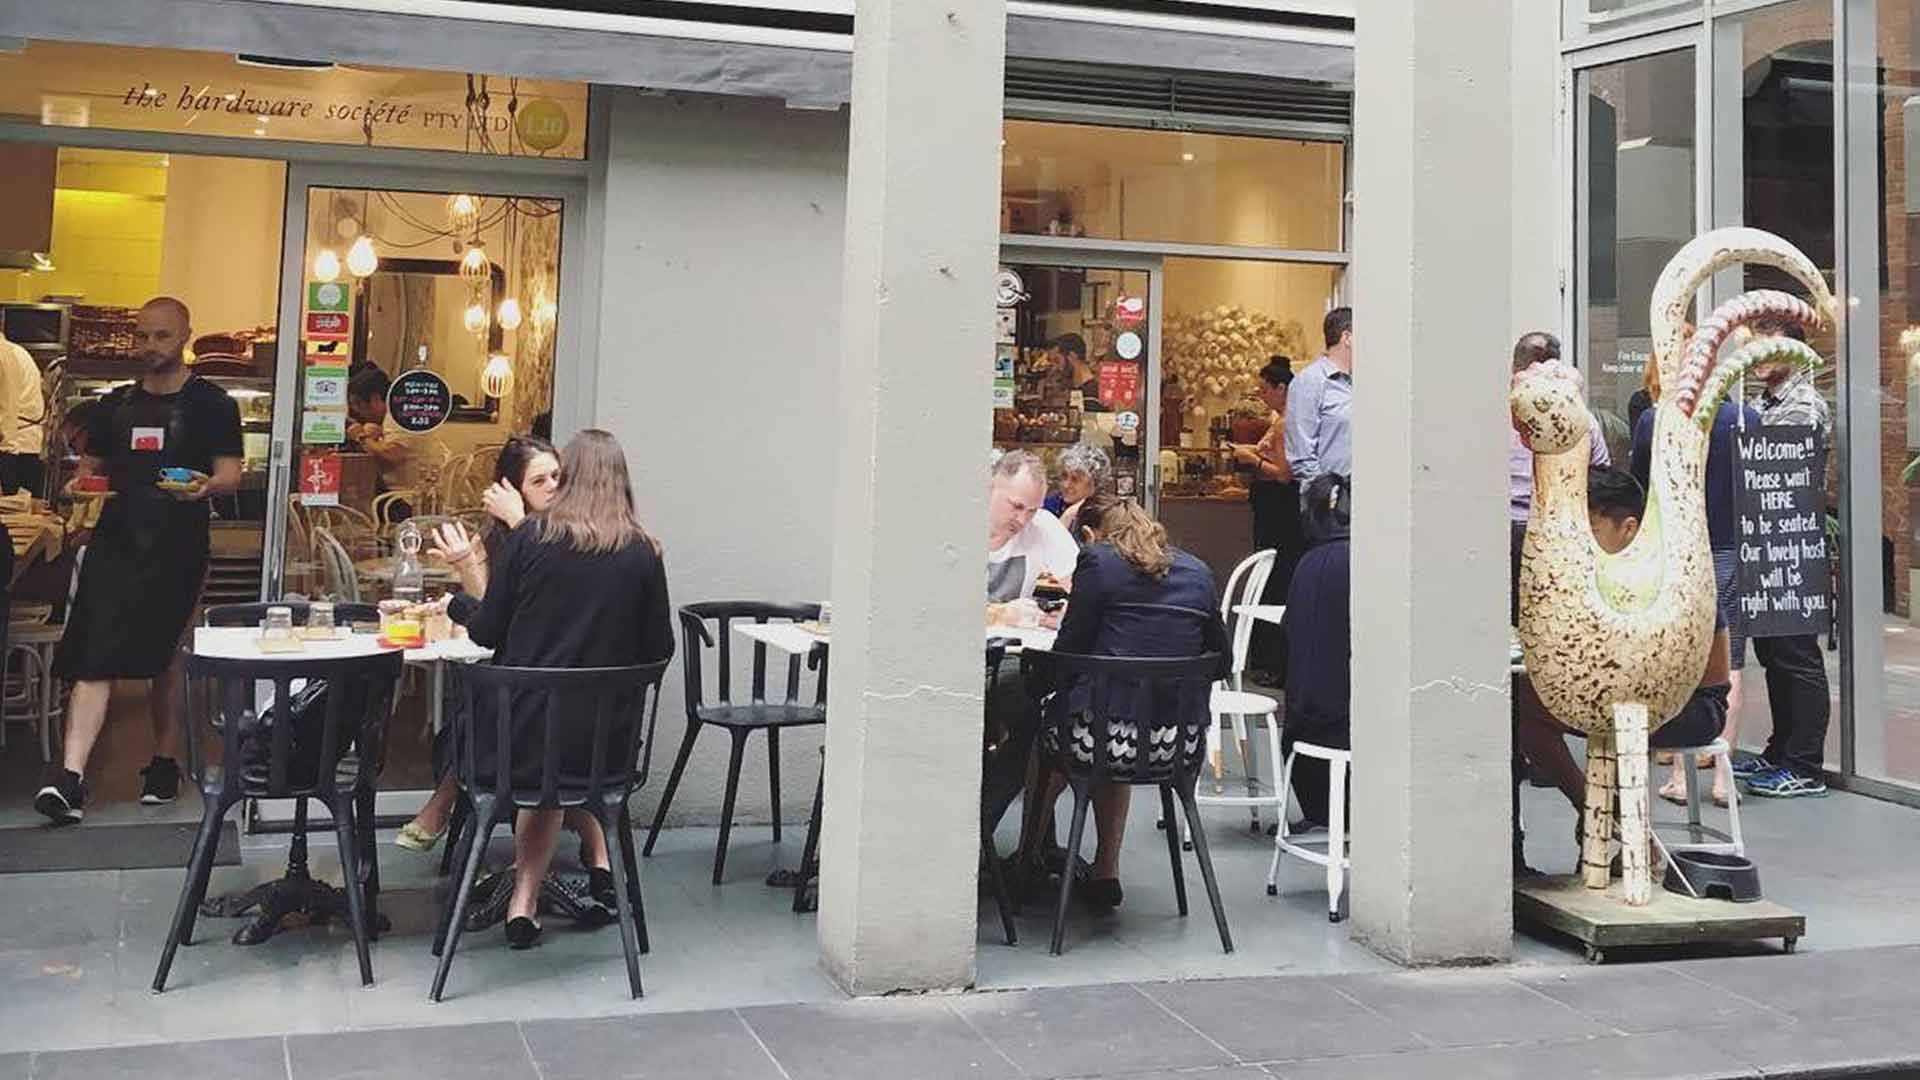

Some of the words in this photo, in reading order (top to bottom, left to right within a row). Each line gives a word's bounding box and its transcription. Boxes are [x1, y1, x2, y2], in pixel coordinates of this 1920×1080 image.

[123, 83, 167, 108] the
[176, 85, 313, 117] hardware
[323, 99, 411, 124] société
[423, 111, 463, 129] PTY
[1737, 436, 1815, 460] Welcome!!
[1744, 469, 1781, 490] Please
[1784, 467, 1810, 487] wait
[1761, 491, 1796, 510] HERE
[1741, 515, 1755, 535] to
[1759, 514, 1773, 535] be
[1779, 512, 1820, 534] seated.
[1740, 542, 1762, 562] Our
[1767, 539, 1799, 569] lovely
[1801, 537, 1826, 559] host
[1760, 566, 1784, 589] will
[1787, 567, 1803, 586] be
[1741, 590, 1768, 619] right
[1772, 590, 1800, 611] with
[1802, 594, 1828, 618] you.
